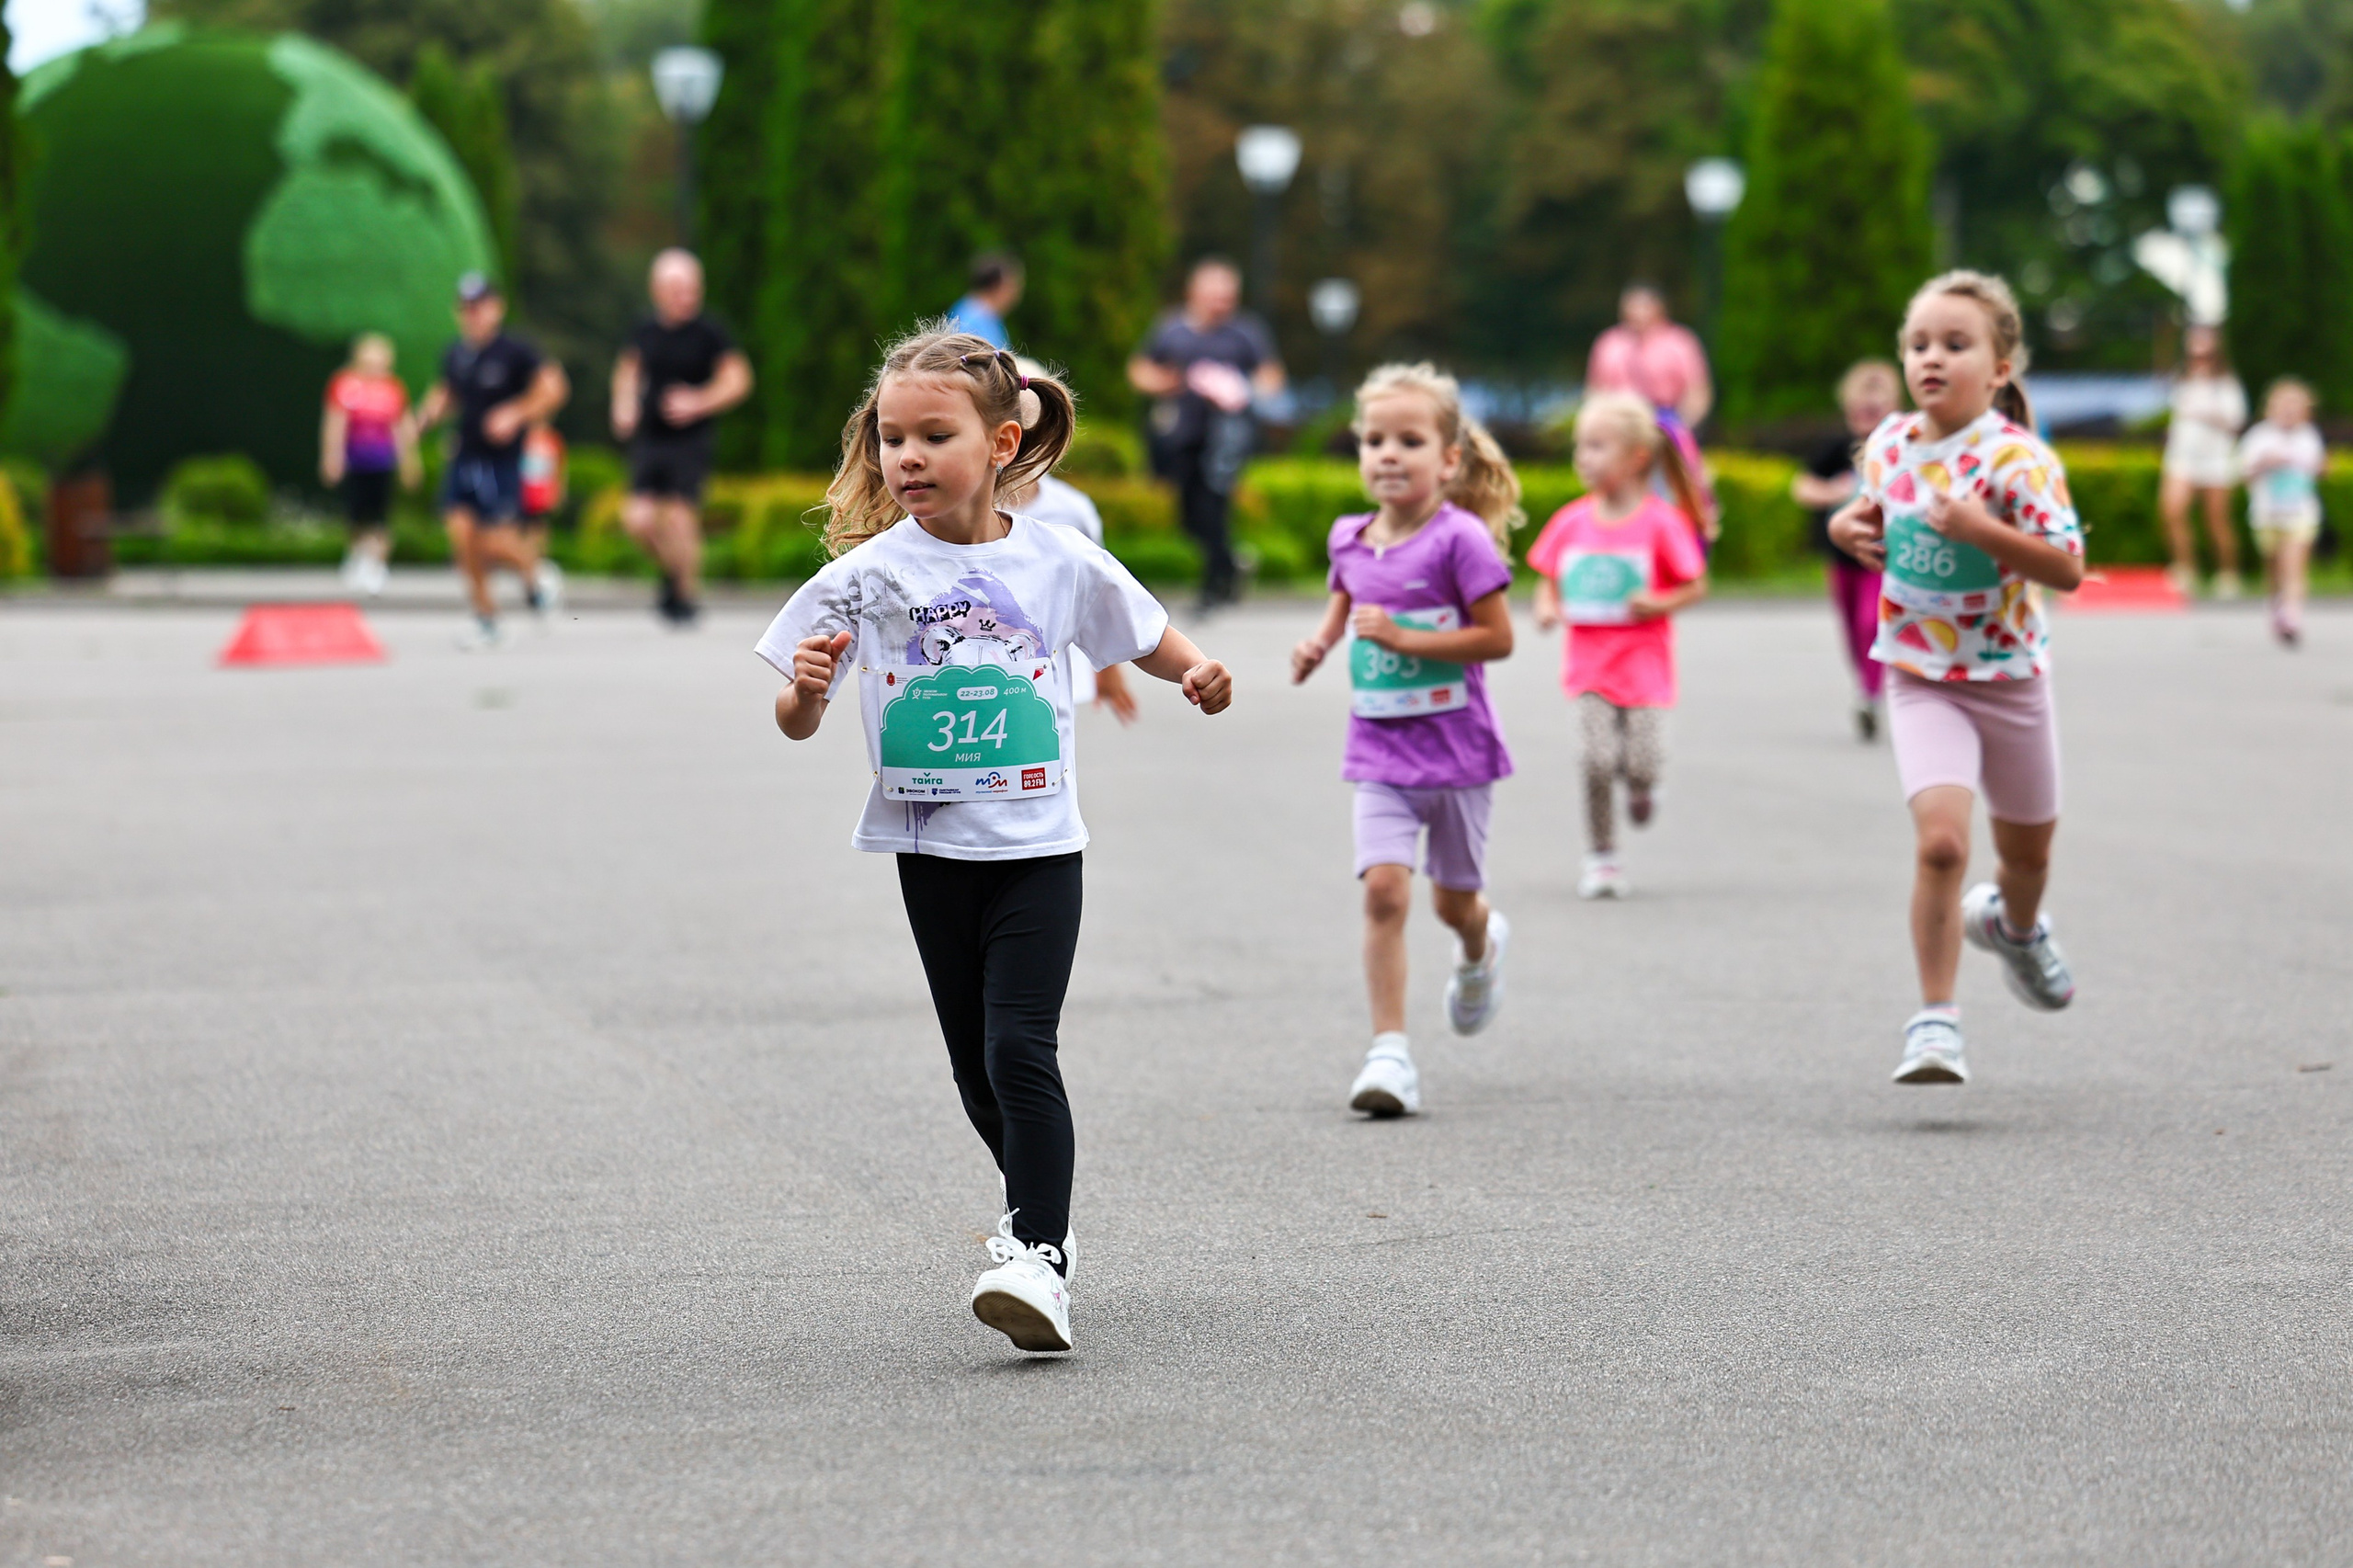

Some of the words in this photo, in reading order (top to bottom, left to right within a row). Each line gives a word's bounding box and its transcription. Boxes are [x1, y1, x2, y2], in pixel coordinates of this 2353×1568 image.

[1896, 541, 1956, 577] 286
[909, 601, 971, 624] HAPPY
[960, 687, 995, 698] 22-23.08
[1003, 687, 1020, 696] 400
[927, 708, 1008, 752] 314
[955, 752, 981, 762] МИЯ
[912, 772, 943, 785] тайга
[1036, 778, 1044, 786] FM
